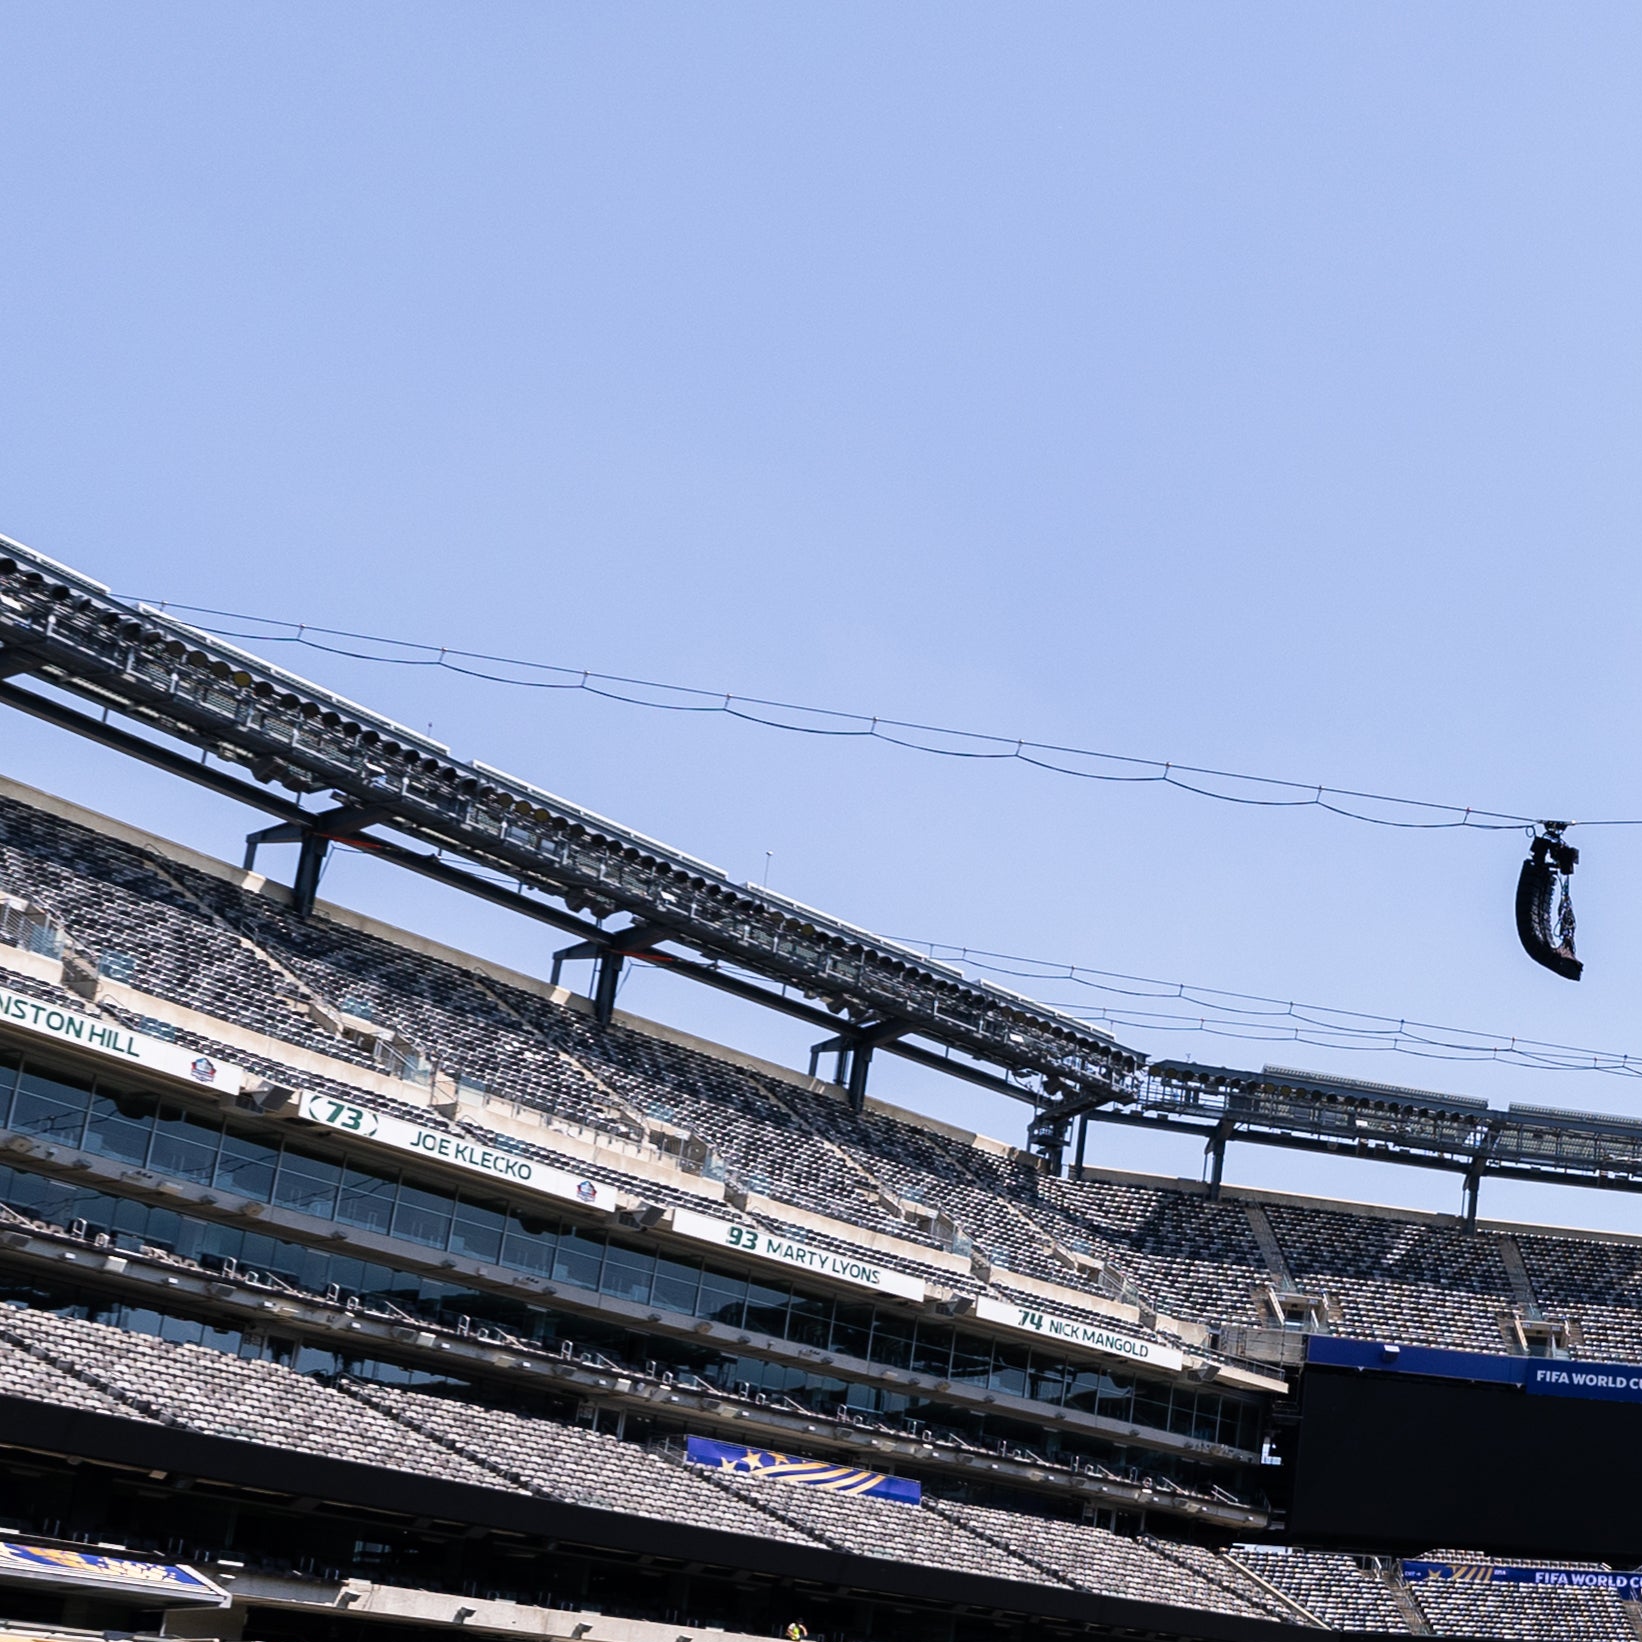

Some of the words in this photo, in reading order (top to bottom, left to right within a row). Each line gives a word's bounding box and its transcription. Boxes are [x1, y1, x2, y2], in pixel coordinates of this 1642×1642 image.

[88, 1024, 140, 1058] HILL
[326, 1101, 364, 1130] 73
[410, 1131, 451, 1156] JOE
[455, 1142, 532, 1180] KLECKO
[727, 1226, 759, 1250] 93
[766, 1239, 829, 1269] MARTY
[832, 1257, 880, 1284] LYONS
[1018, 1309, 1044, 1330] 74
[1049, 1319, 1080, 1340] NICK
[1082, 1328, 1149, 1358] MANGOLD
[1536, 1370, 1570, 1384] FIFA
[1571, 1373, 1627, 1388] WORLD
[1535, 1571, 1568, 1585] FIFA
[1571, 1573, 1628, 1587] WORLD
